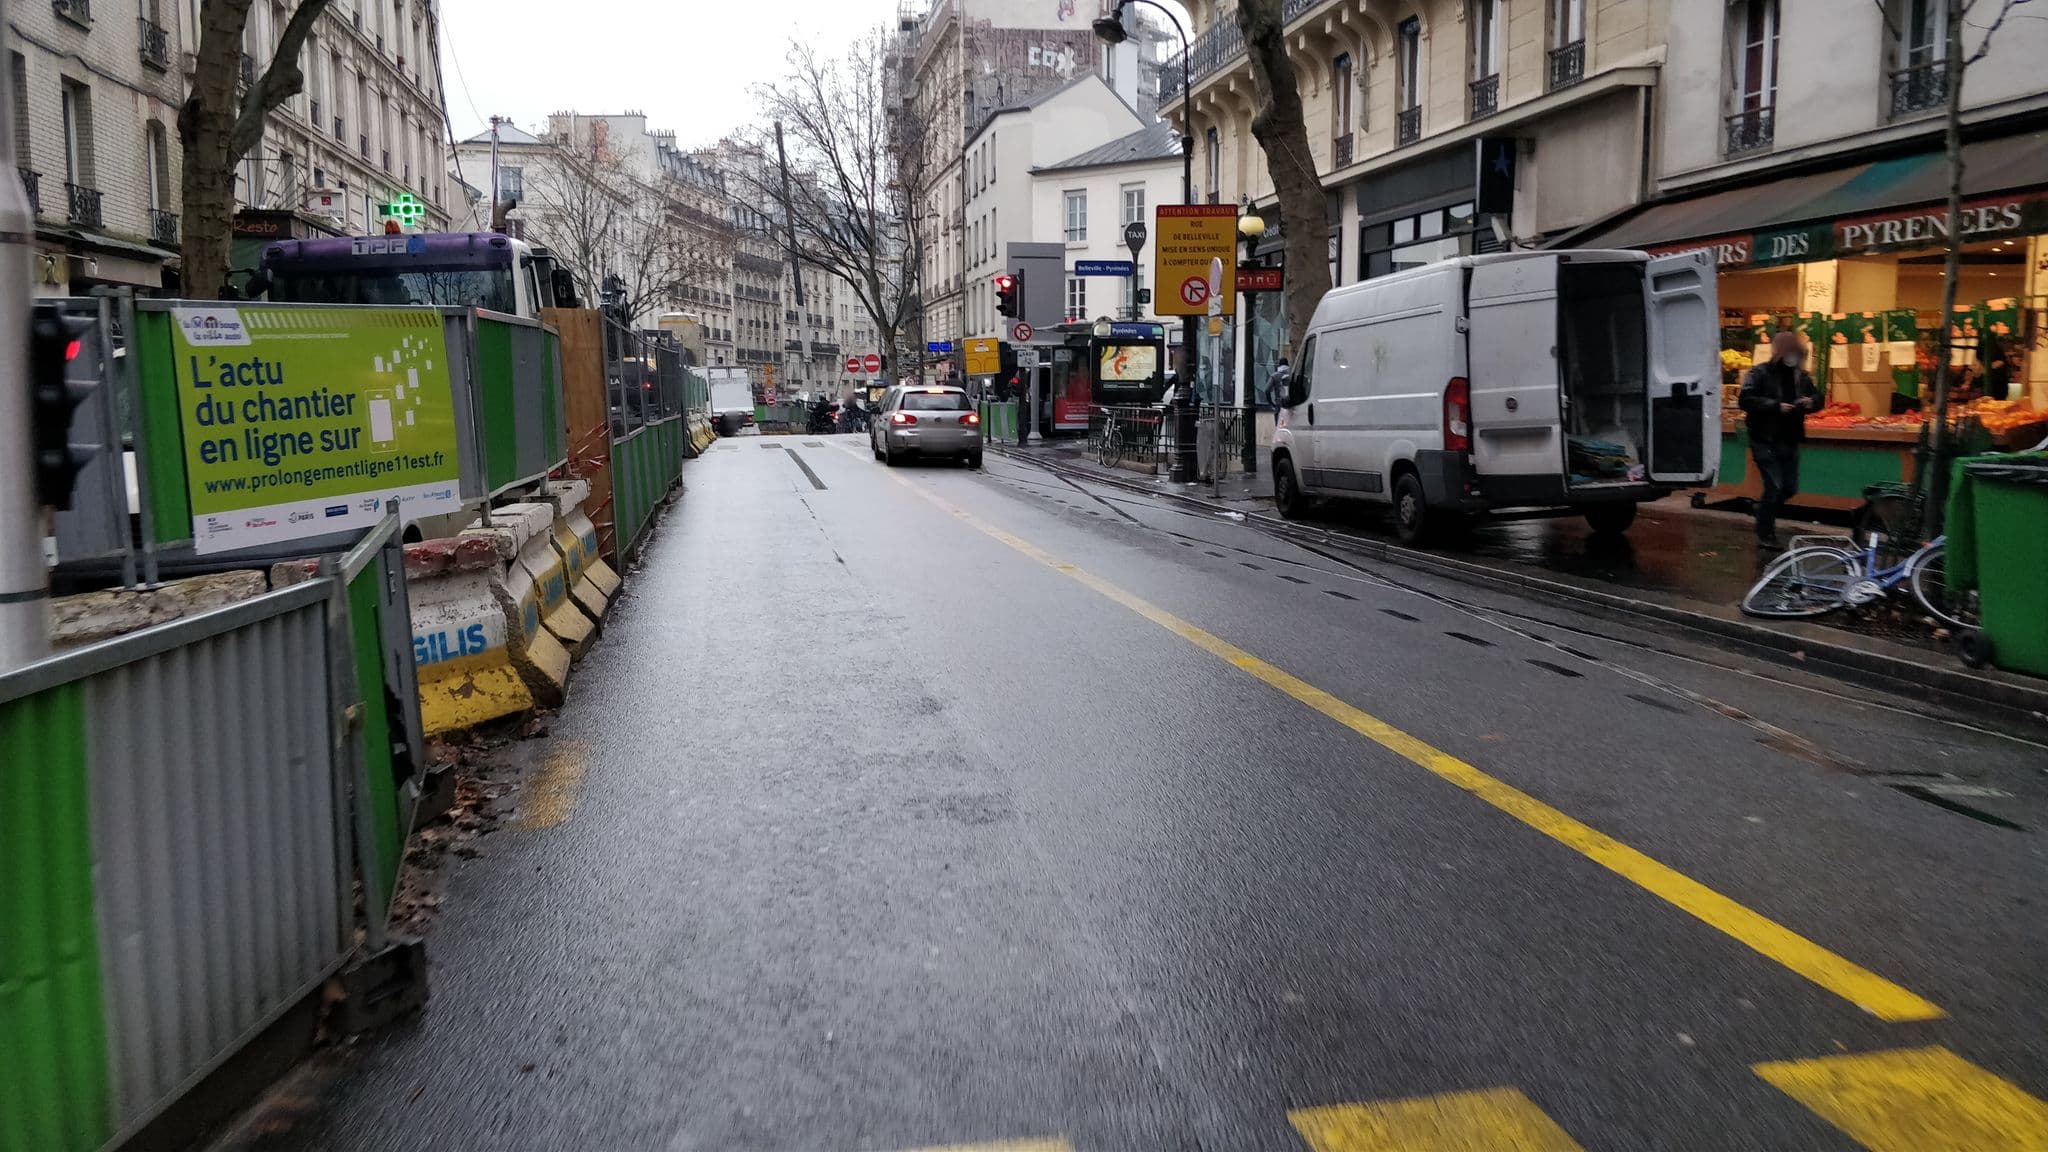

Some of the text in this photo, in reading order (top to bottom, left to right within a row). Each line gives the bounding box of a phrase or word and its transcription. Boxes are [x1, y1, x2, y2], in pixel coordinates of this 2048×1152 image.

[1160, 207, 1236, 215] ATTENTION TRAVAUX
[1190, 220, 1203, 228] RUE
[1127, 231, 1145, 239] TAXI
[1771, 232, 1809, 259] DES
[1168, 258, 1198, 266] COMPTER
[196, 387, 356, 427] du chantier
[200, 426, 361, 467] en ligne sur
[205, 452, 444, 494] www.prolongementligne11est.fr
